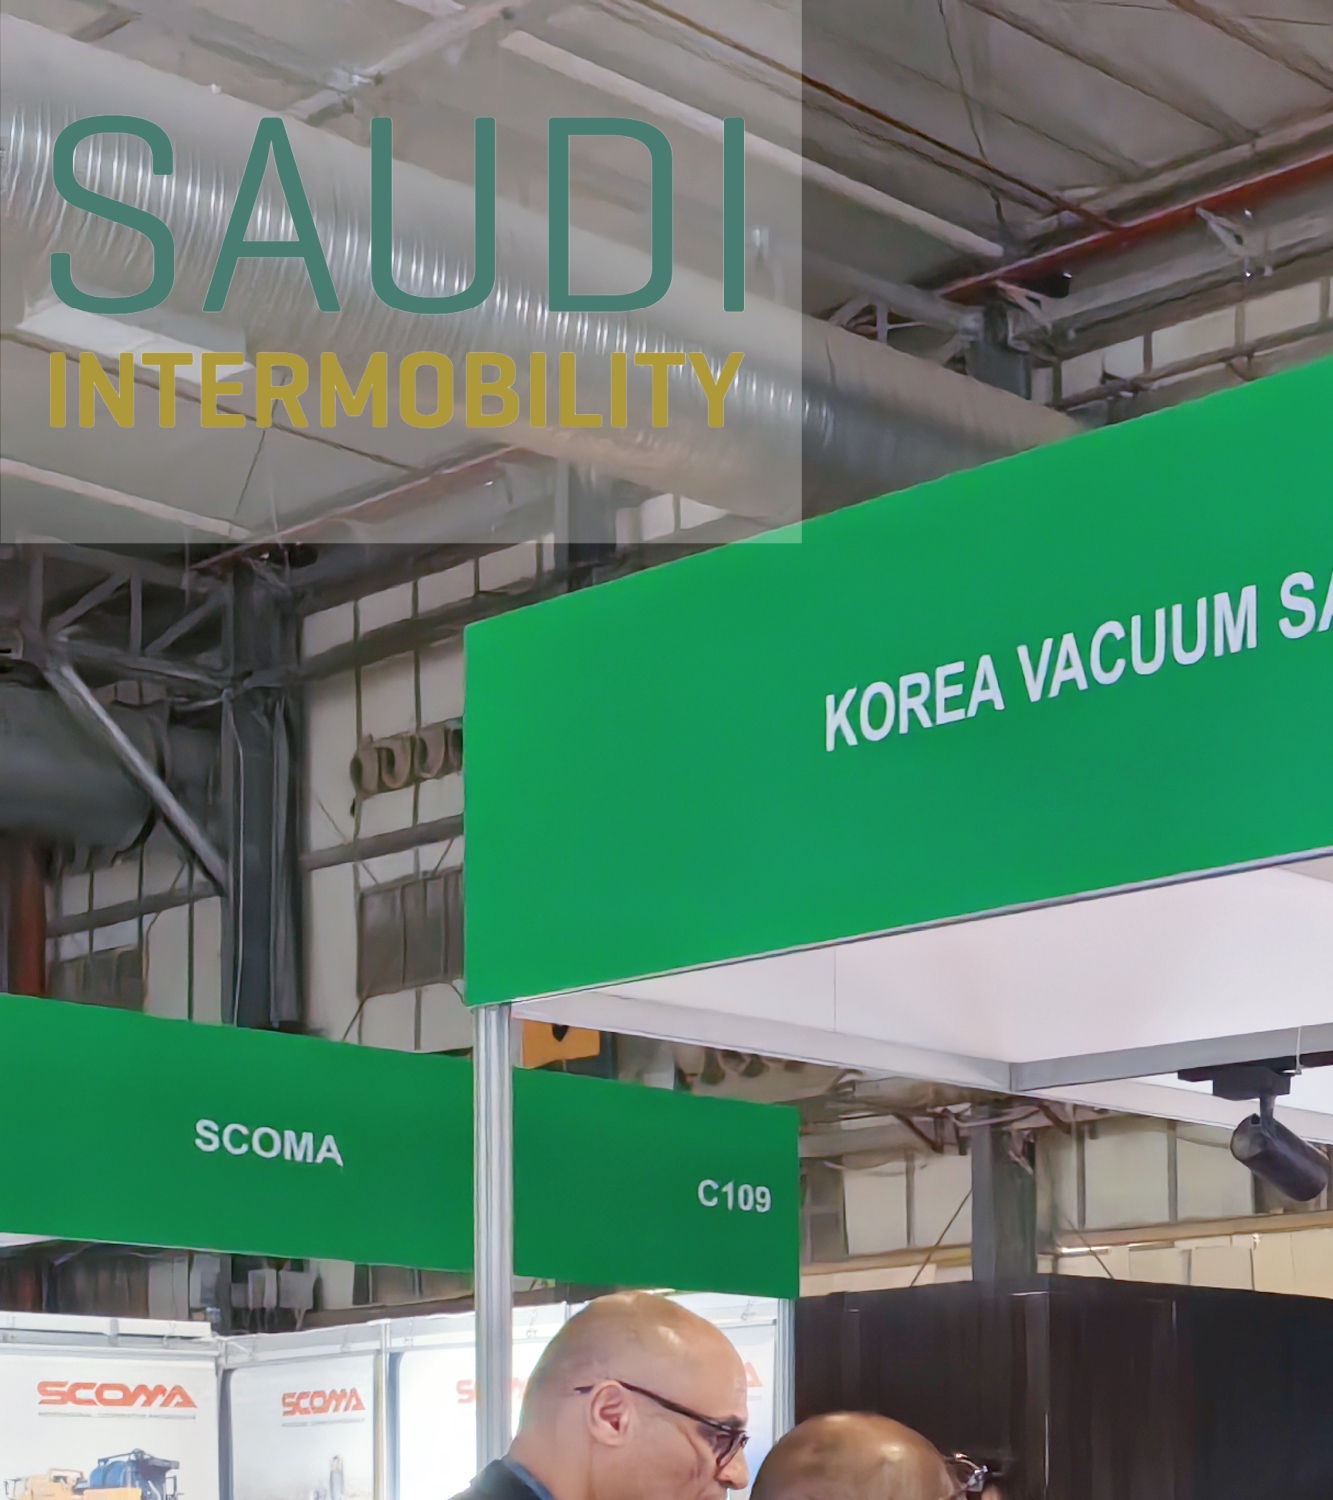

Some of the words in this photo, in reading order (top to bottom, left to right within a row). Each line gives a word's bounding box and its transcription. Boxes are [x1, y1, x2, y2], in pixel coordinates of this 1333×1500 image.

[825, 654, 1005, 752] KOREA
[1016, 584, 1258, 703] VACUUM
[194, 1119, 344, 1167] SCOMA
[697, 1179, 772, 1214] C109
[37, 1380, 198, 1409] SCOMA
[281, 1387, 366, 1417] SCOMA
